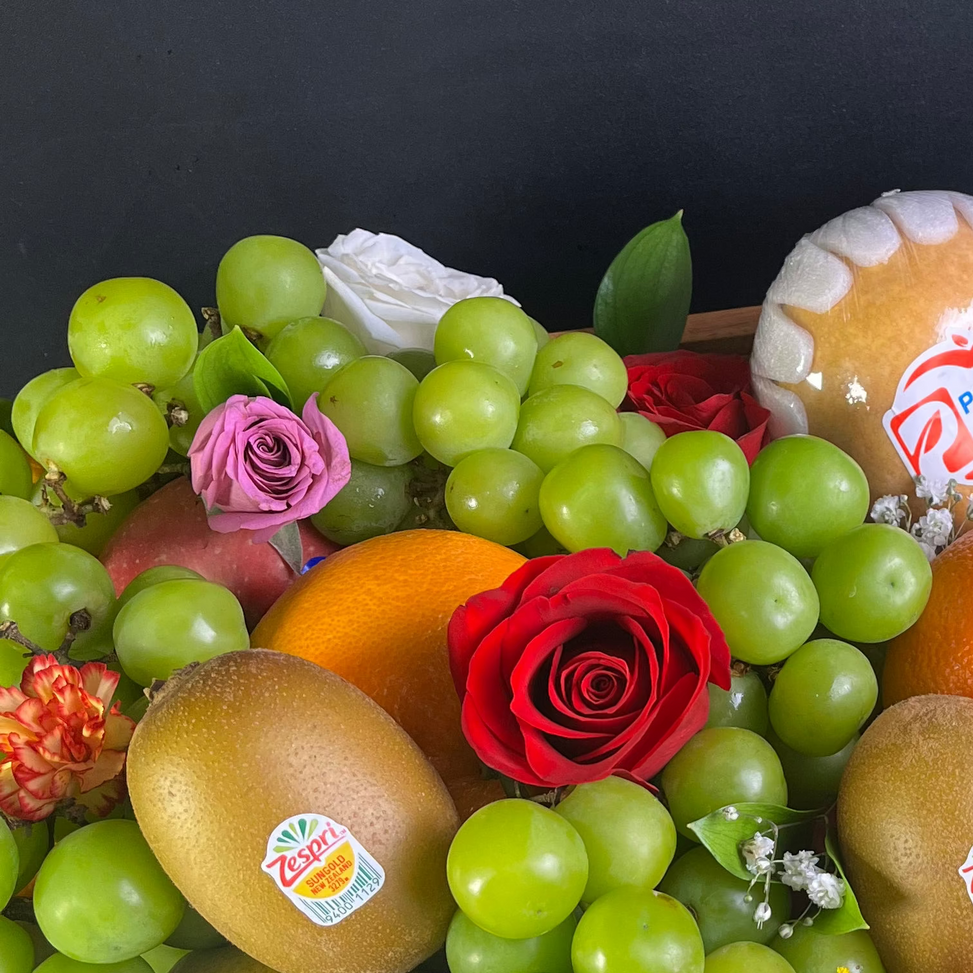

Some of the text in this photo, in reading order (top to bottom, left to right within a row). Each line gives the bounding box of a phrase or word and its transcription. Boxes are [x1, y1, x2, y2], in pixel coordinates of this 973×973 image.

[266, 821, 343, 888] Zespri
[305, 854, 346, 888] SUNGOLD
[310, 860, 353, 896] NEW ZEALAND
[328, 877, 345, 893] 3279
[325, 877, 381, 923] 9400 1129
